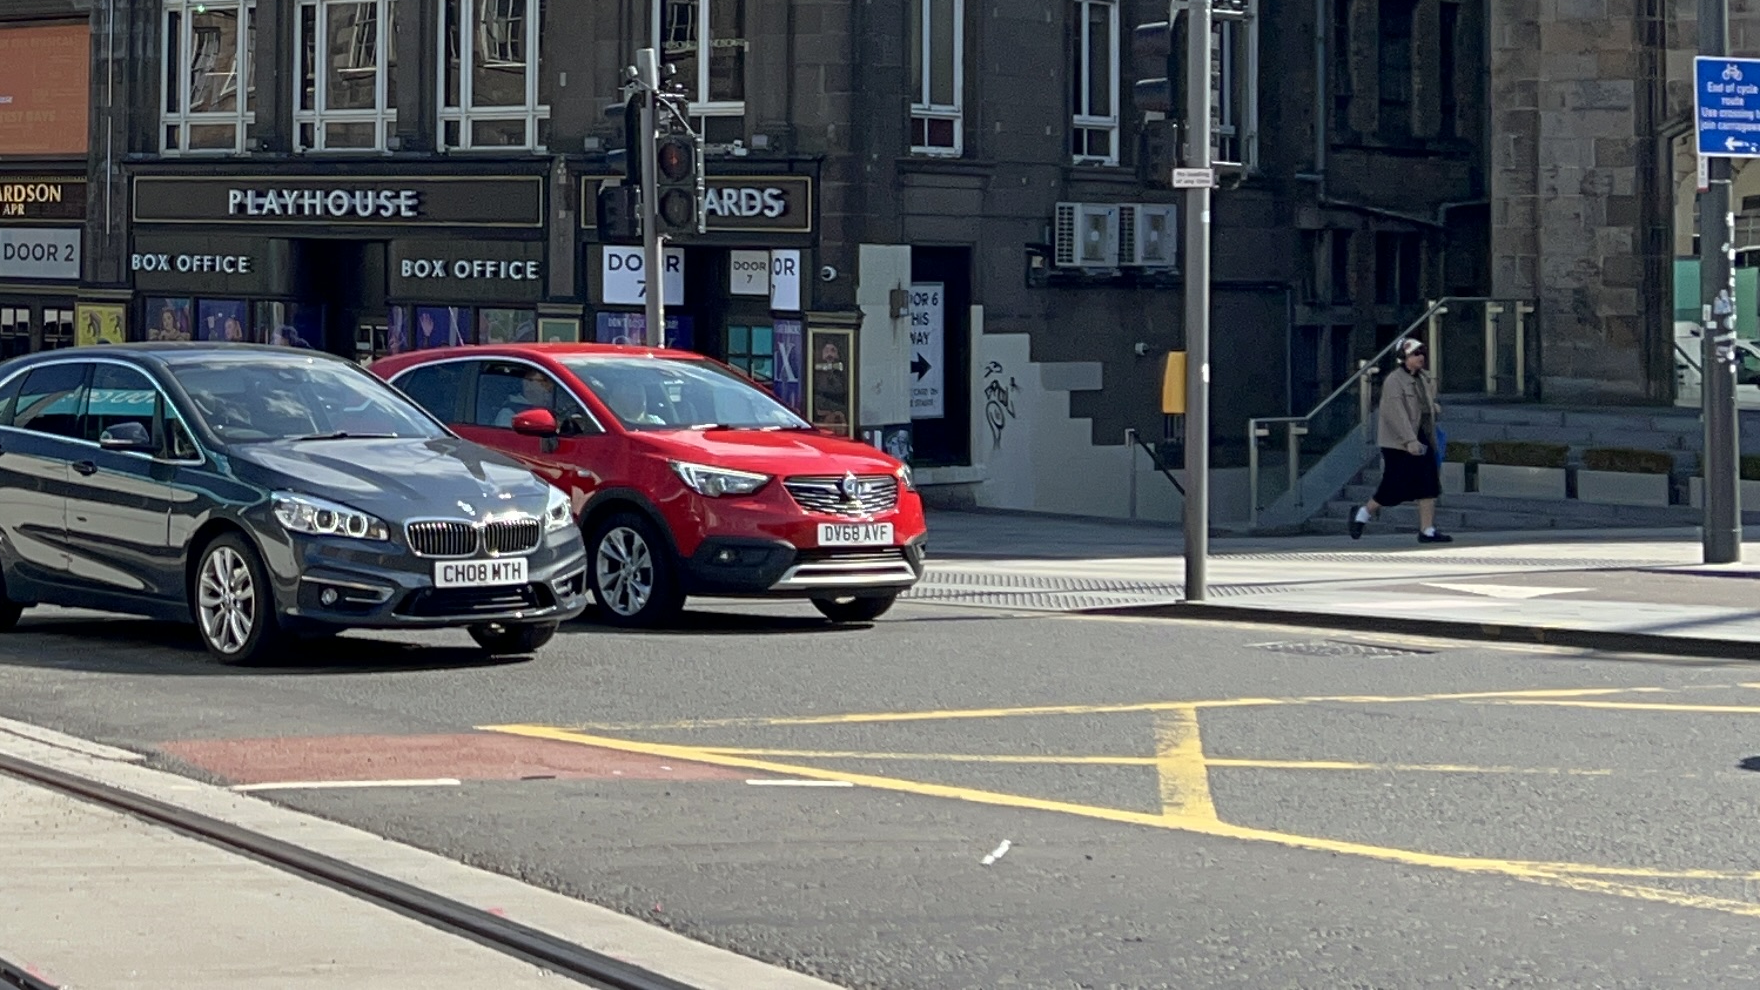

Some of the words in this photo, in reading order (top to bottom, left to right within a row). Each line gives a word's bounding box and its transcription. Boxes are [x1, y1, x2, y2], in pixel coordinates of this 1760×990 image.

[1721, 97, 1745, 106] route
[2, 203, 25, 216] APR
[228, 188, 418, 217] PLAYHOUSE
[703, 188, 785, 218] ARDS
[4, 243, 58, 261] DOOR
[64, 244, 74, 261] 2
[131, 253, 170, 272] BOX
[176, 254, 251, 274] OFFICE
[401, 259, 445, 278] BOX
[454, 260, 539, 280] OFFICE
[609, 253, 680, 272] DOR
[733, 261, 767, 272] DOOR
[771, 258, 795, 276] OR
[746, 275, 753, 284] 7
[910, 291, 929, 307] OR
[932, 291, 939, 307] 6
[911, 312, 930, 326] HIS
[444, 563, 487, 583] CH08
